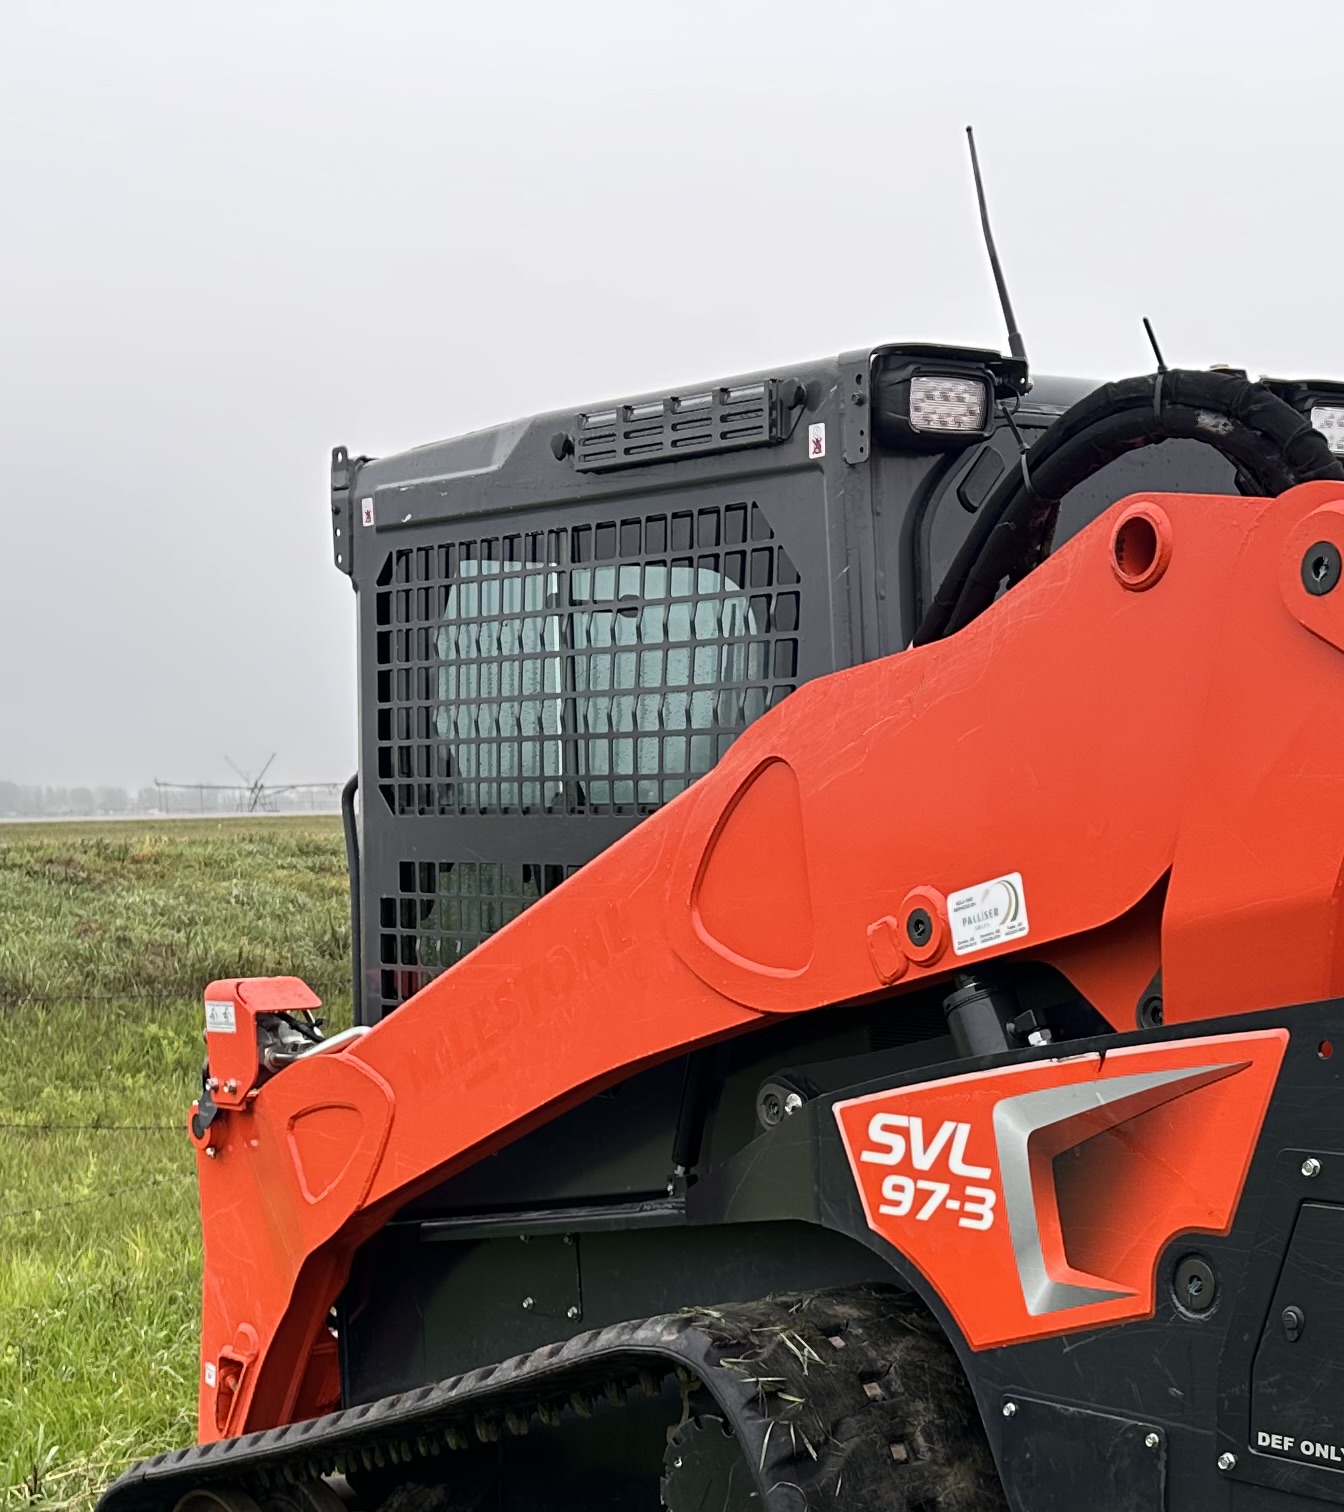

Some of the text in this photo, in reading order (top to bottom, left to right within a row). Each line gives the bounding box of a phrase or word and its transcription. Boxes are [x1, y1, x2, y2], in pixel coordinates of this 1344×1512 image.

[859, 1112, 992, 1180] SVL
[878, 1175, 997, 1231] 97-3
[1257, 1431, 1295, 1451] DEF
